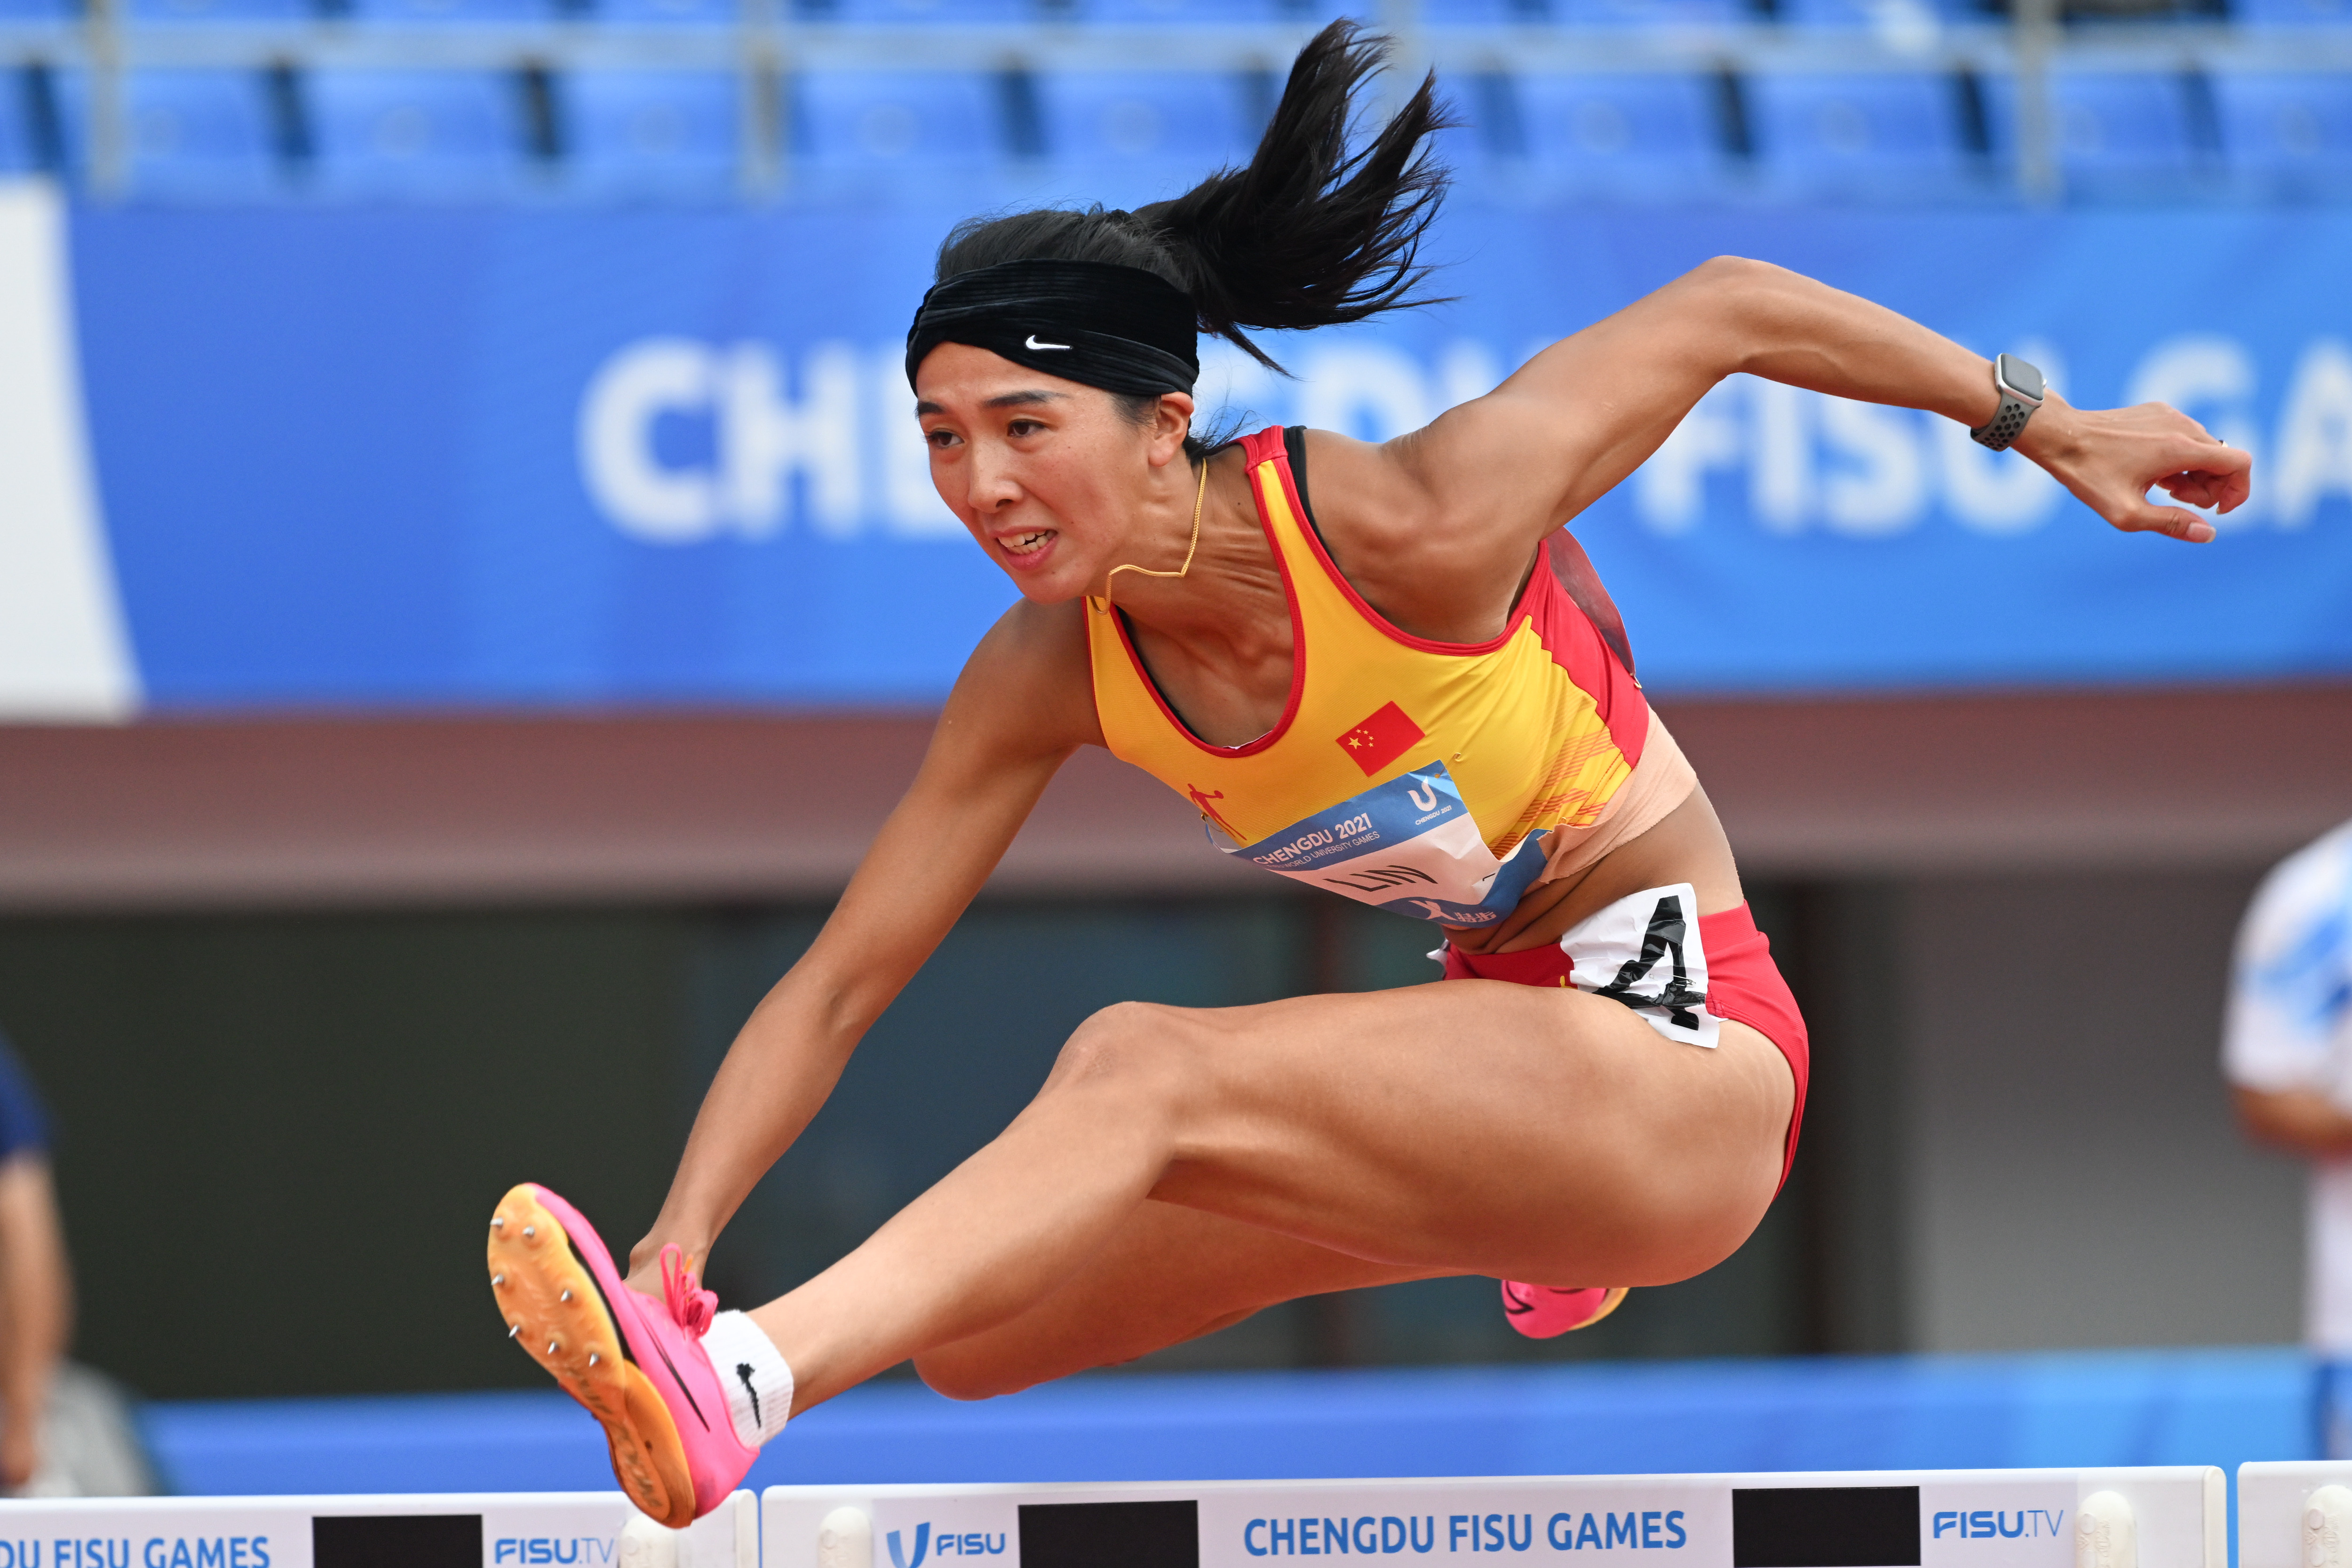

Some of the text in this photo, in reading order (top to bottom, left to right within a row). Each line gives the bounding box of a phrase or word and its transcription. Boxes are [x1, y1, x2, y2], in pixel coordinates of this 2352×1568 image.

[1415, 805, 1452, 825] CHENGDU 2021
[1253, 812, 1372, 864] CHENGDU 2021
[1284, 831, 1380, 867] WORLD UNIVERSITY GAMES
[1322, 865, 1438, 892] LIN
[1591, 895, 1706, 1031] 4
[1244, 1510, 1686, 1556] CHENGDU FISU GAMES
[1933, 1509, 2064, 1539] FISU.TV
[54, 1538, 129, 1568] FISU
[144, 1536, 270, 1568] GAMES
[495, 1537, 614, 1564] FISU.TV
[936, 1533, 1005, 1556] FISU
